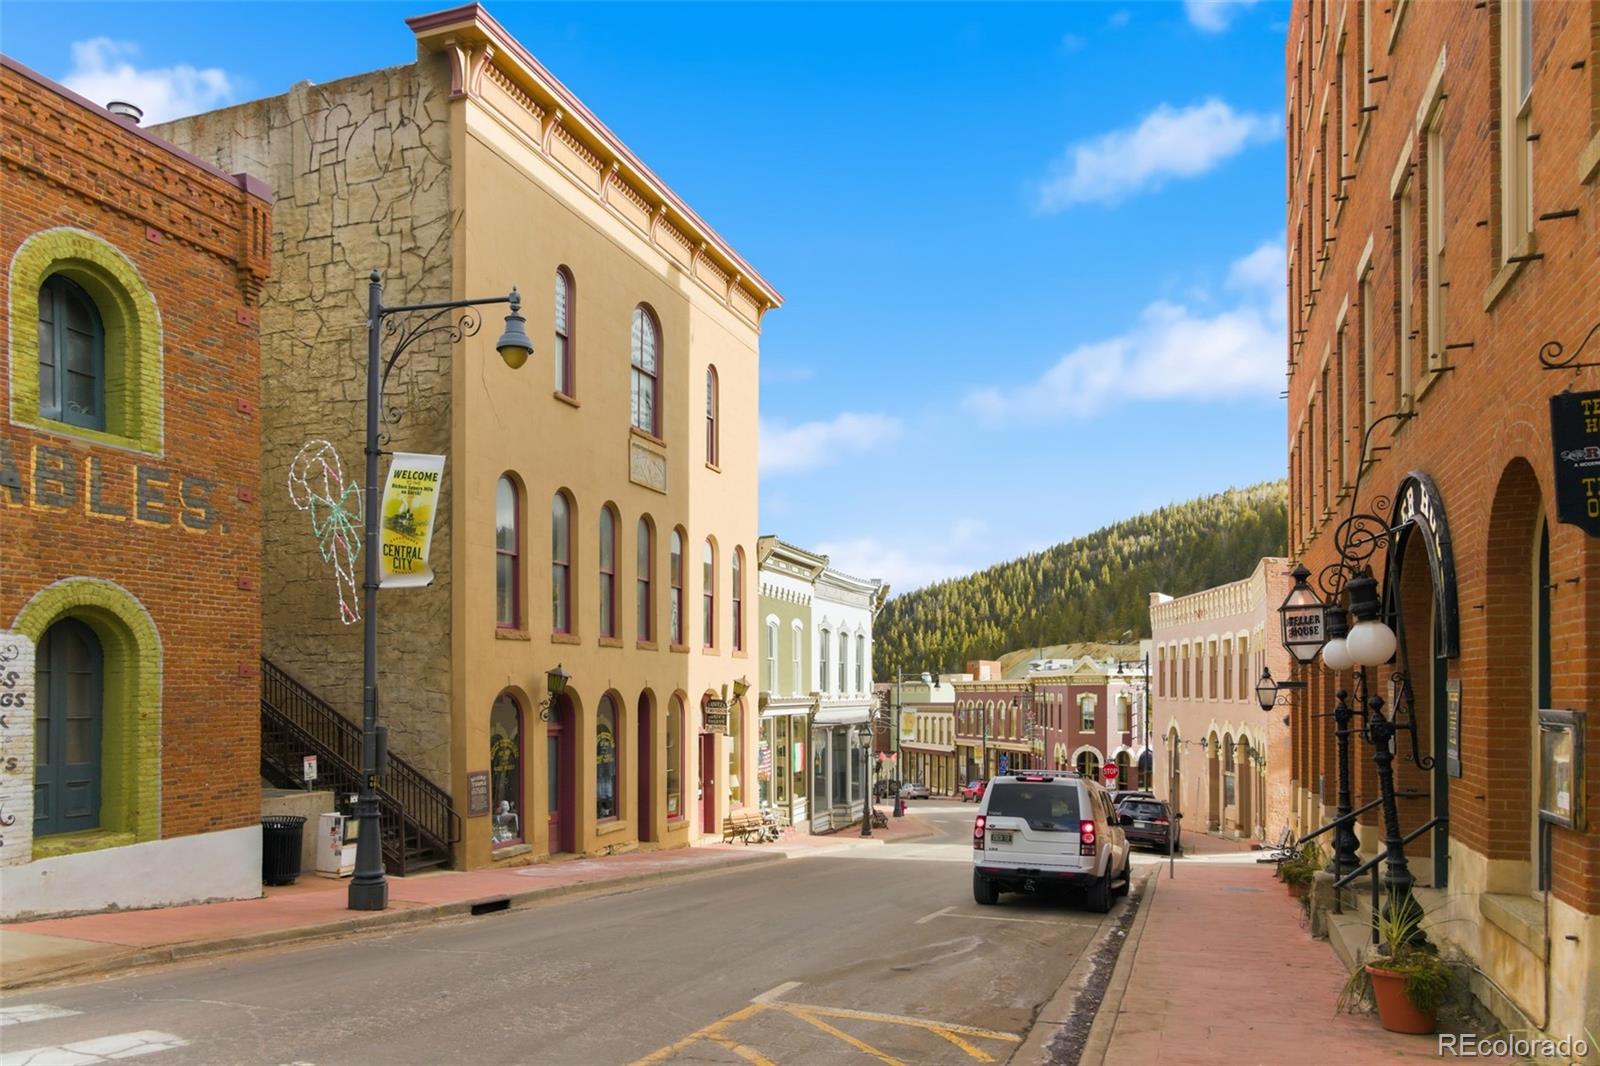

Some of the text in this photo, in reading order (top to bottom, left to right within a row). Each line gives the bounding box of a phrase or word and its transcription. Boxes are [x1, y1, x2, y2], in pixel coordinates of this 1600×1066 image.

[393, 470, 438, 482] WELCOME
[383, 543, 423, 560] CENTRAL
[393, 557, 413, 570] CITY
[1290, 625, 1319, 637] HOUSE
[1103, 767, 1118, 775] STOP
